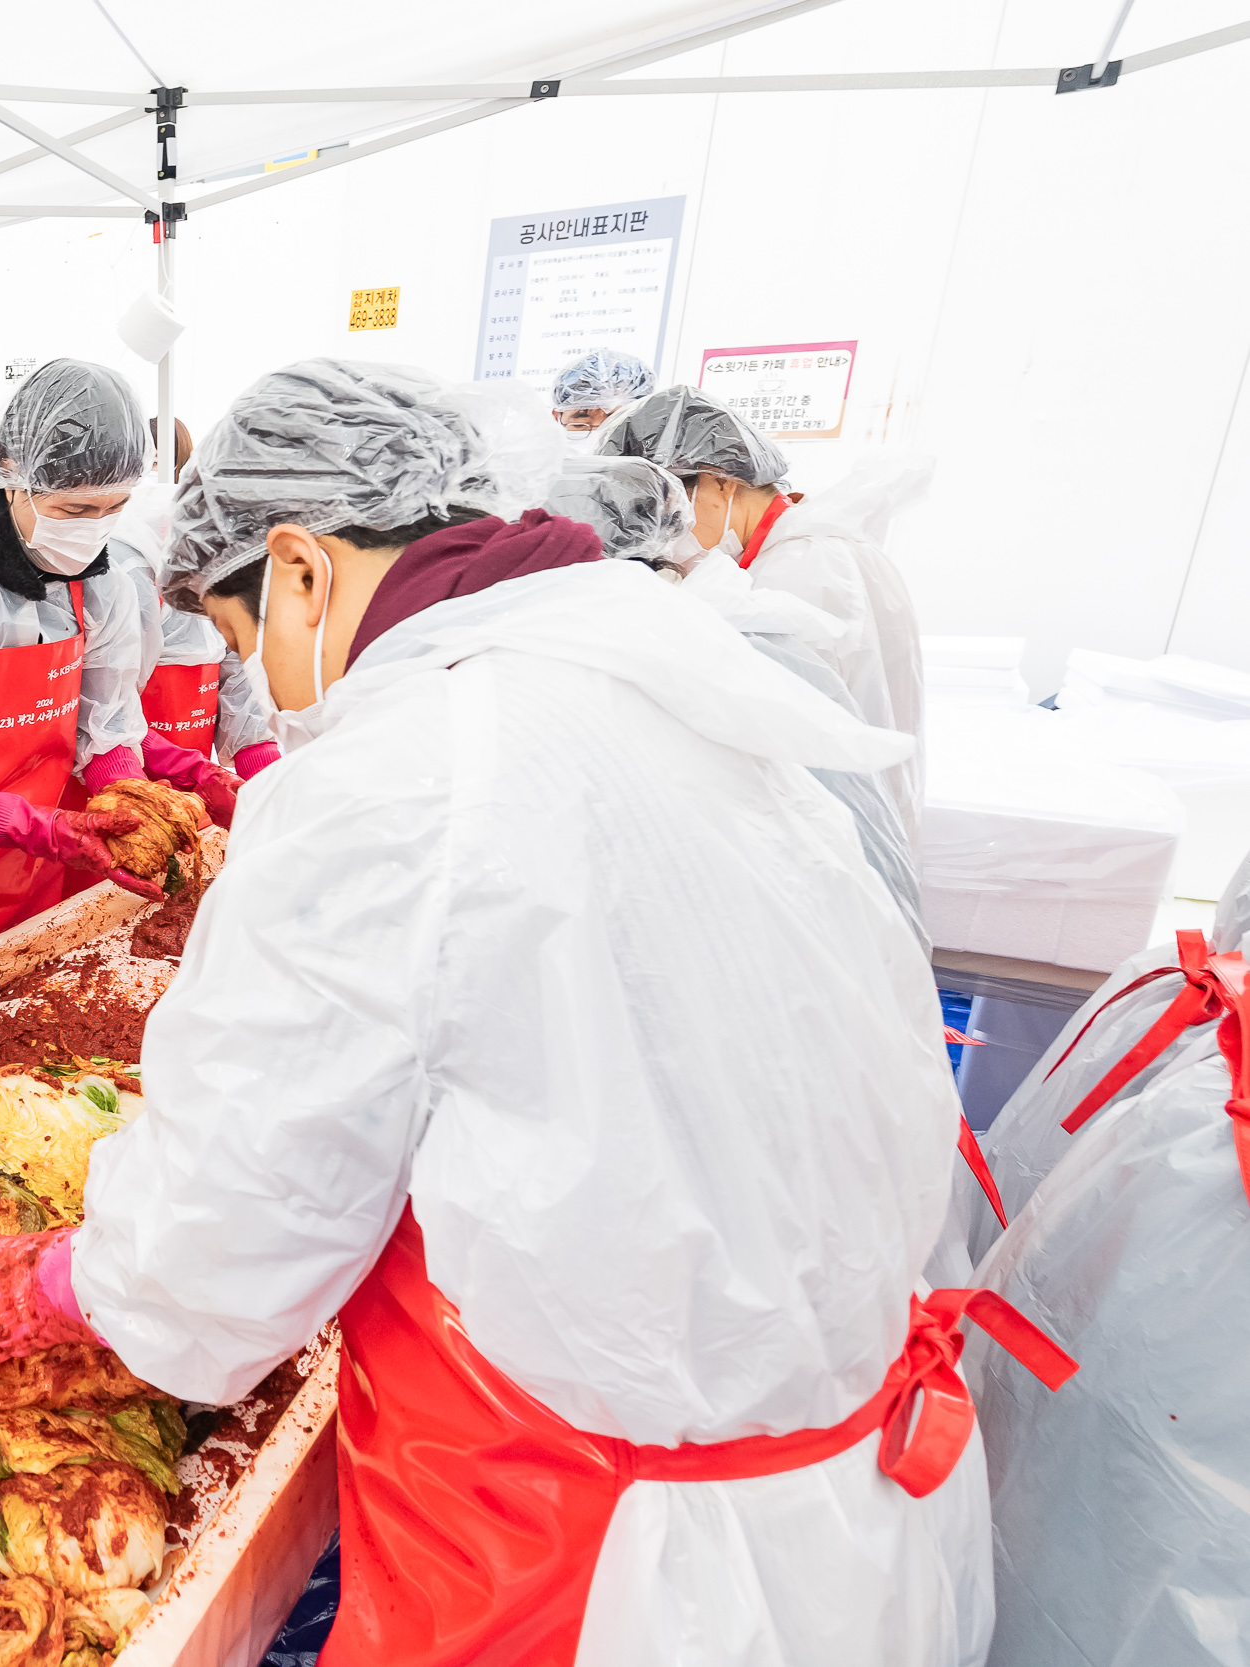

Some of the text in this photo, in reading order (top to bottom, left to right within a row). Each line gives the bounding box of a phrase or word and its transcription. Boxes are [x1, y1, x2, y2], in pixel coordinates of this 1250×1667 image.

[519, 210, 649, 245] 공사안내표지판
[364, 290, 397, 306] 지게차
[350, 307, 397, 329] 469-3838
[761, 358, 786, 371] 카페
[789, 357, 813, 369] 휴업
[728, 394, 811, 408] 리모델링 기간 중
[750, 408, 809, 420] 휴업합니다.
[769, 421, 778, 430] 후
[782, 421, 800, 430] 영업
[802, 420, 826, 430] 재개)
[35, 698, 54, 709] 2024
[16, 713, 36, 726] 광진
[36, 706, 61, 722] 사랑의
[190, 709, 206, 717] 2024
[149, 721, 173, 732] 제2회
[174, 721, 191, 732] 광진
[191, 717, 212, 729] 사랑의
